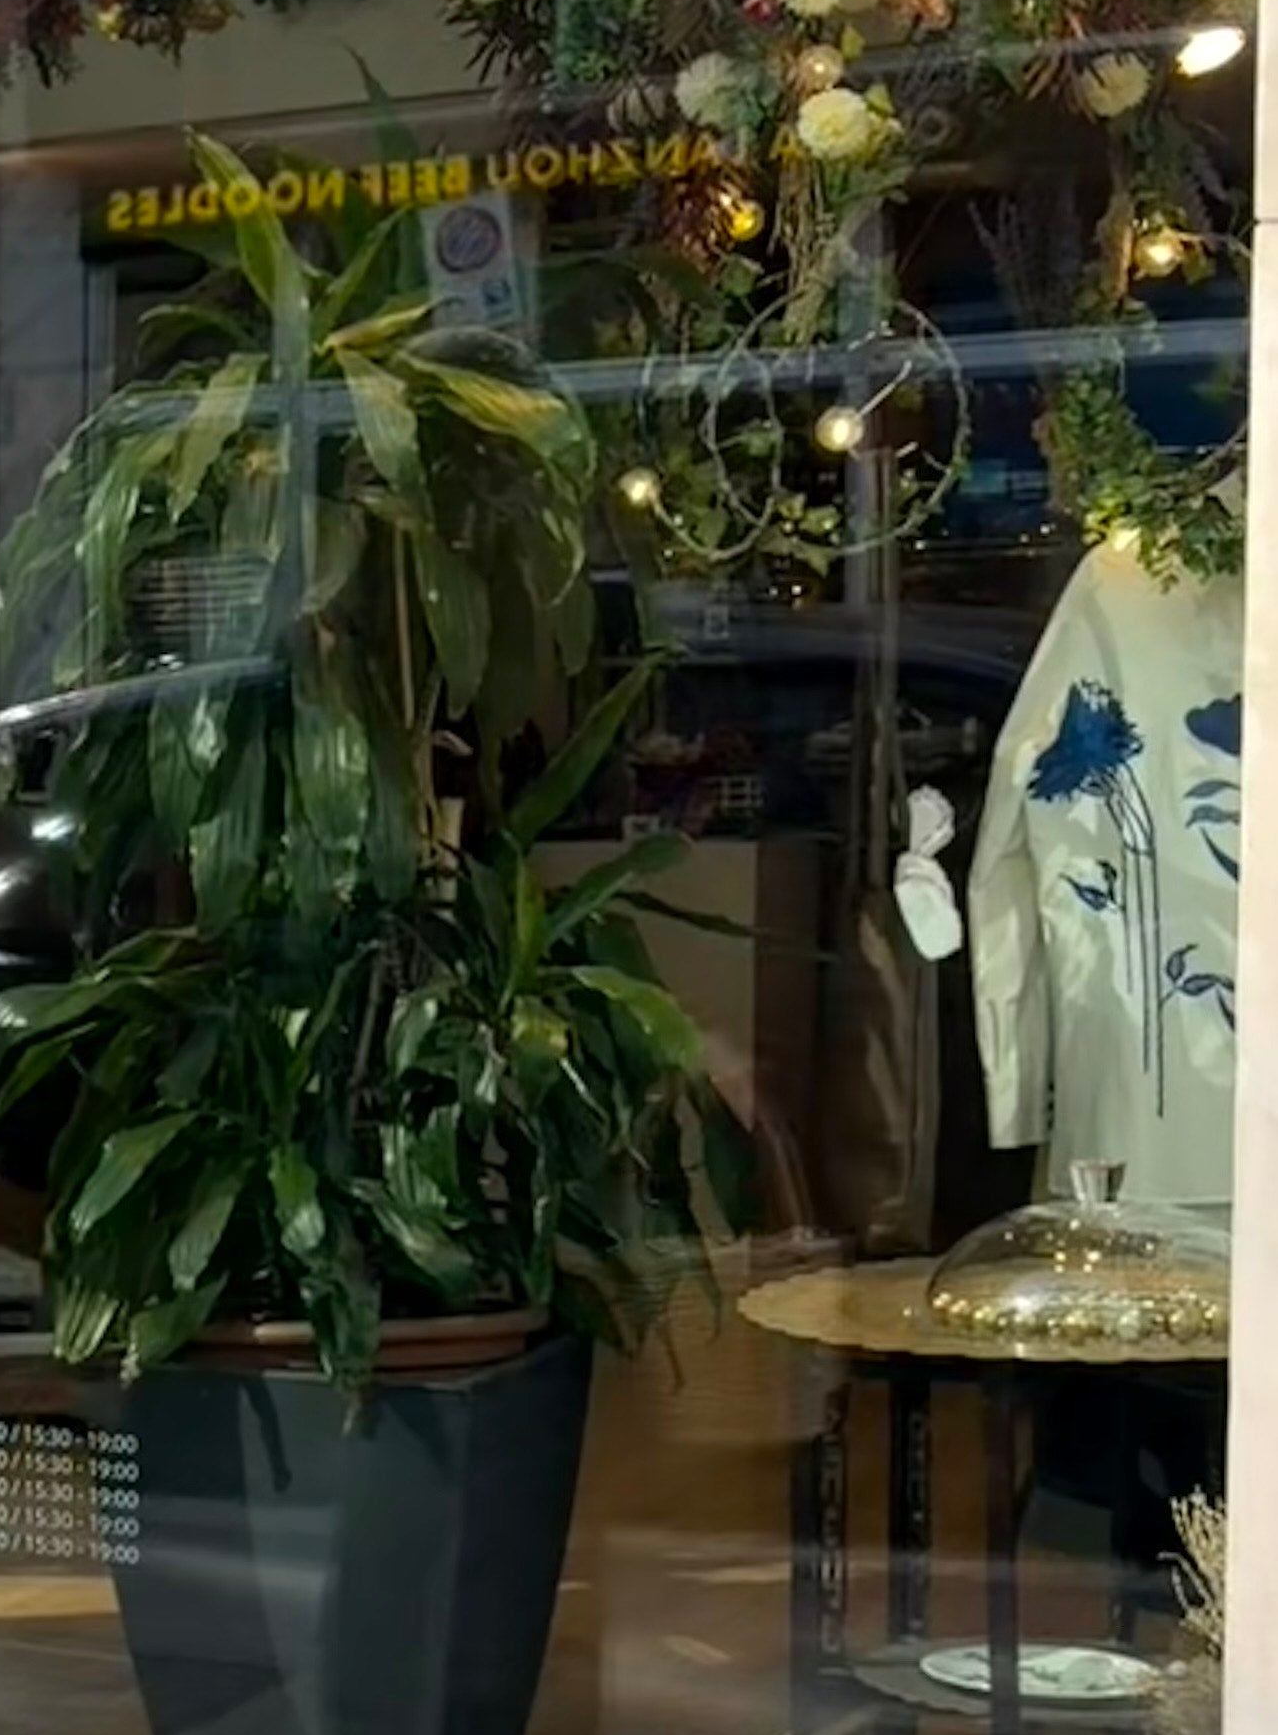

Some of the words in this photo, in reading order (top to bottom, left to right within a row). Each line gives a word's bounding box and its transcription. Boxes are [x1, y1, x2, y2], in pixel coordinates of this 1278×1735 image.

[87, 1431, 139, 1455] 19:00
[88, 1457, 139, 1482] 19:00
[89, 1485, 139, 1510] 19:00
[89, 1513, 140, 1538] 19:00
[89, 1541, 140, 1565] 19:00
